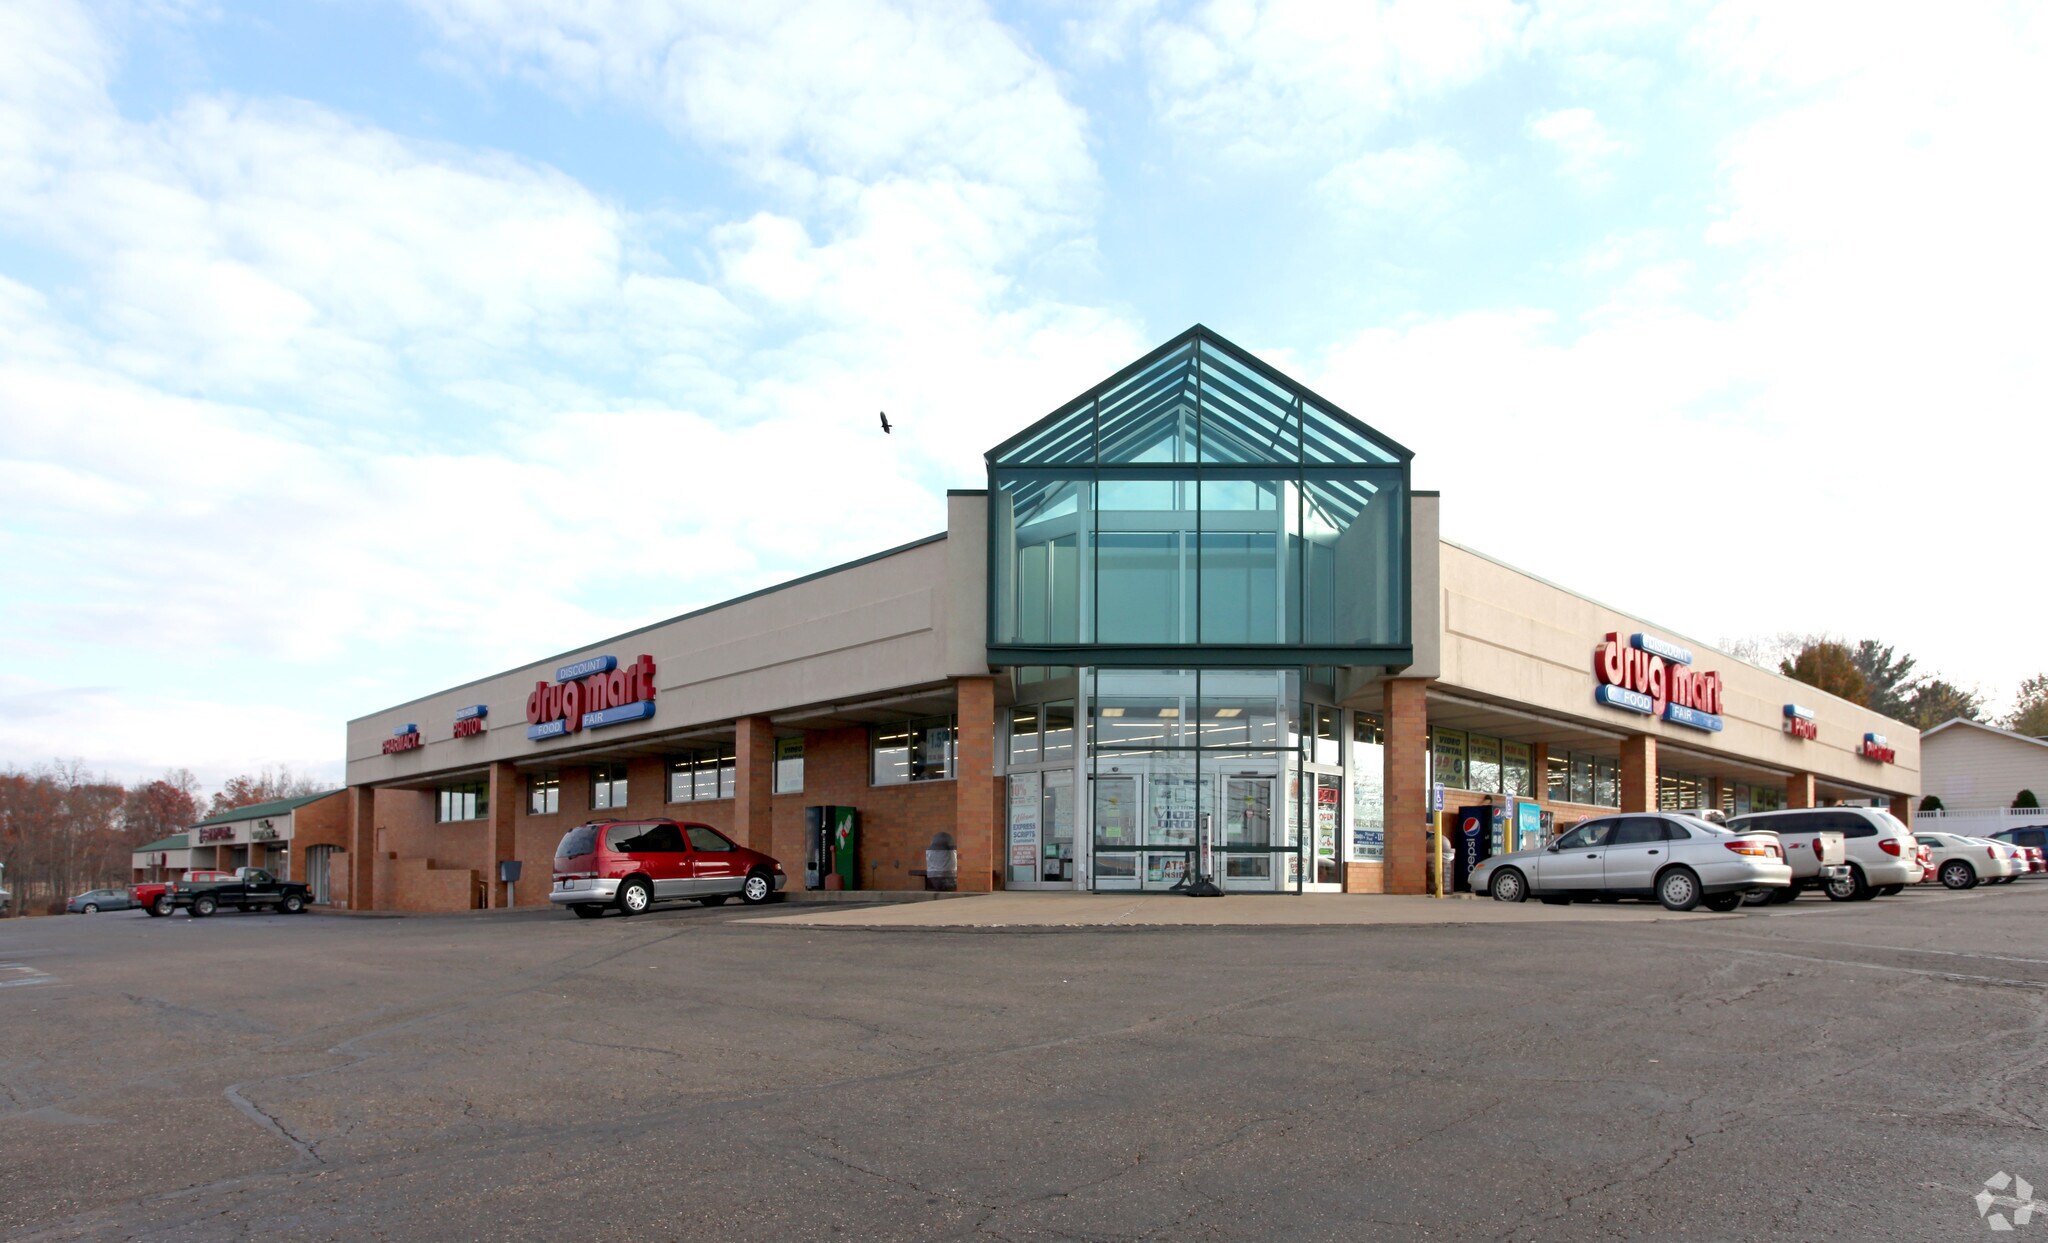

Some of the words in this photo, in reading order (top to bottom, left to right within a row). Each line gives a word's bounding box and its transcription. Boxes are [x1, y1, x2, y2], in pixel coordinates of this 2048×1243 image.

[1647, 639, 1689, 661] DISCOUNT
[559, 659, 601, 679] DISCOUNT
[1600, 631, 1668, 716] drug
[1671, 670, 1723, 717] mart
[526, 680, 581, 732] drug
[586, 653, 654, 712] mart
[1623, 691, 1651, 710] FOOD
[583, 712, 603, 725] FAIR
[1673, 705, 1693, 721] FAIR
[453, 717, 478, 739] PHOTO
[537, 721, 563, 735] FOOD
[1795, 717, 1818, 741] PHOTO
[382, 733, 418, 755] PHARMACY
[1435, 744, 1462, 756] RENTAL
[1438, 735, 1461, 746] VIDEO
[1013, 822, 1036, 831] EXPRESS
[1013, 831, 1036, 839] SCRIPTS
